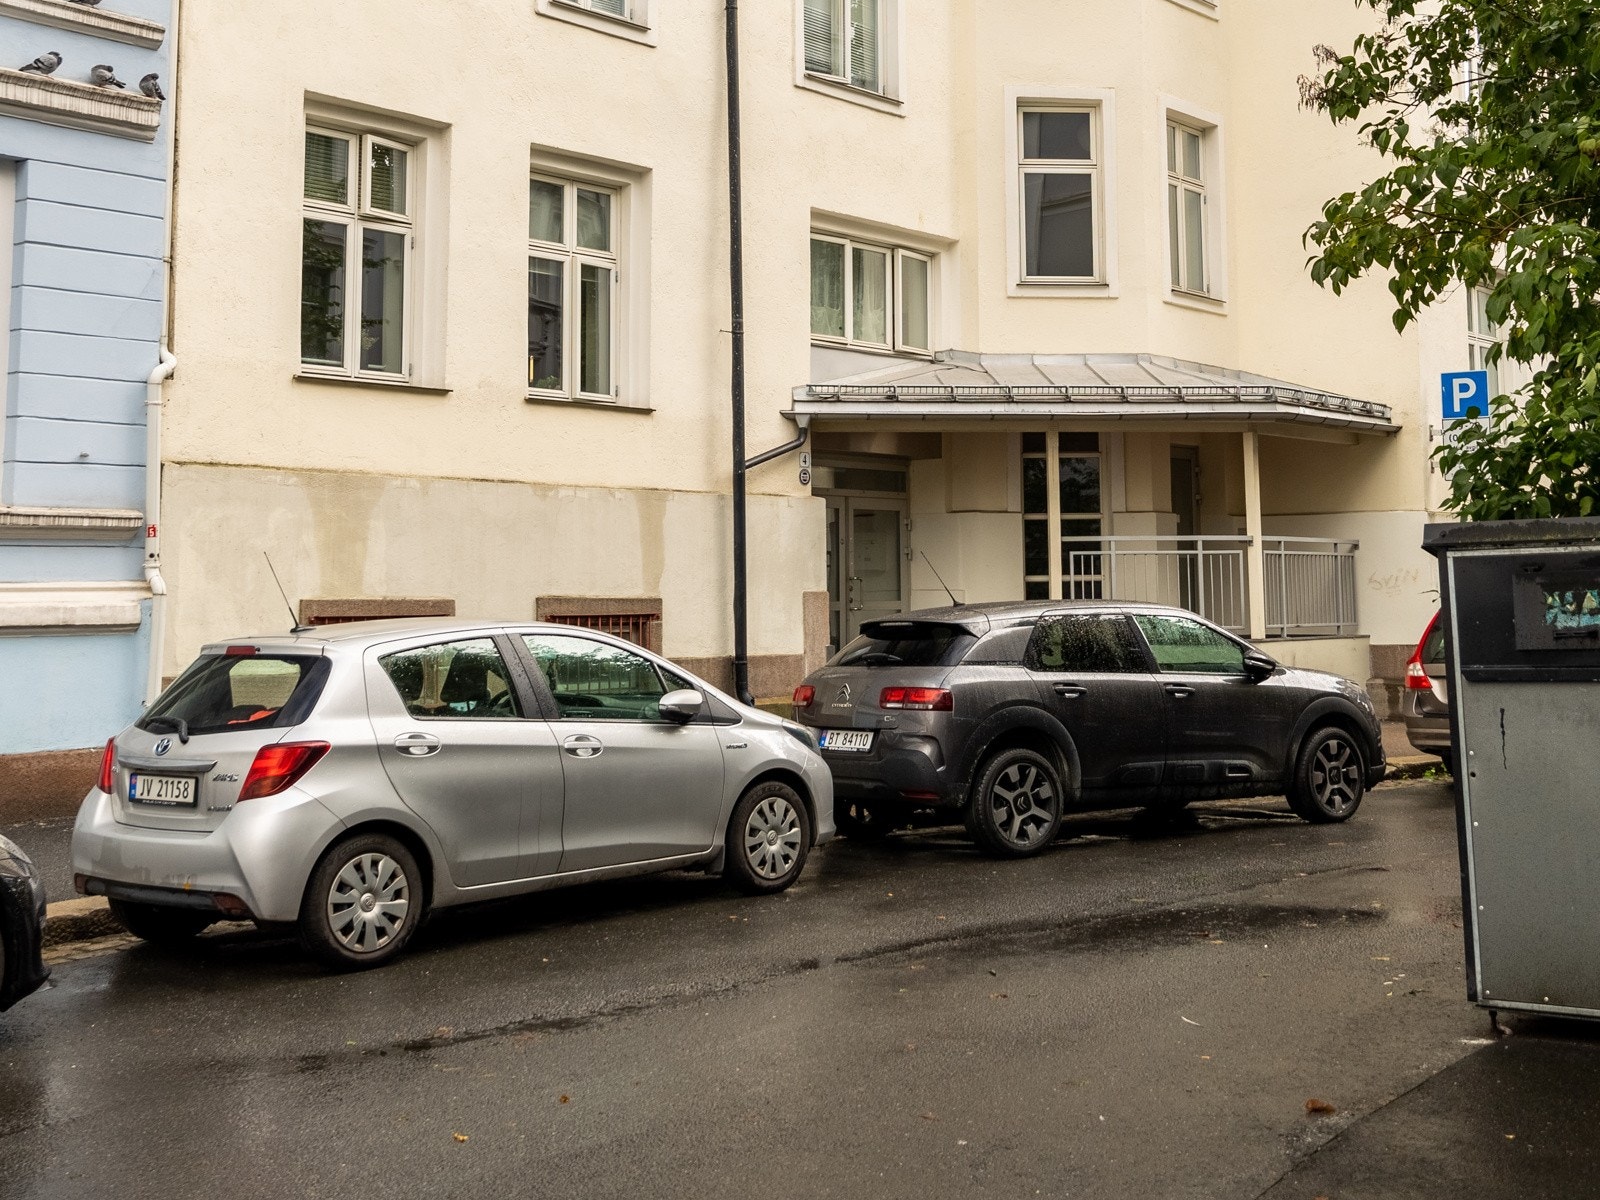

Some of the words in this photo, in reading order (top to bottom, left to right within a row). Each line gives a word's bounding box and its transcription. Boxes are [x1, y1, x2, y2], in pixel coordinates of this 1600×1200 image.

[1452, 377, 1477, 413] P
[802, 454, 807, 465] 4
[828, 732, 840, 745] BT
[842, 732, 869, 746] 84110
[140, 778, 153, 796] JV
[157, 779, 190, 799] 21158
